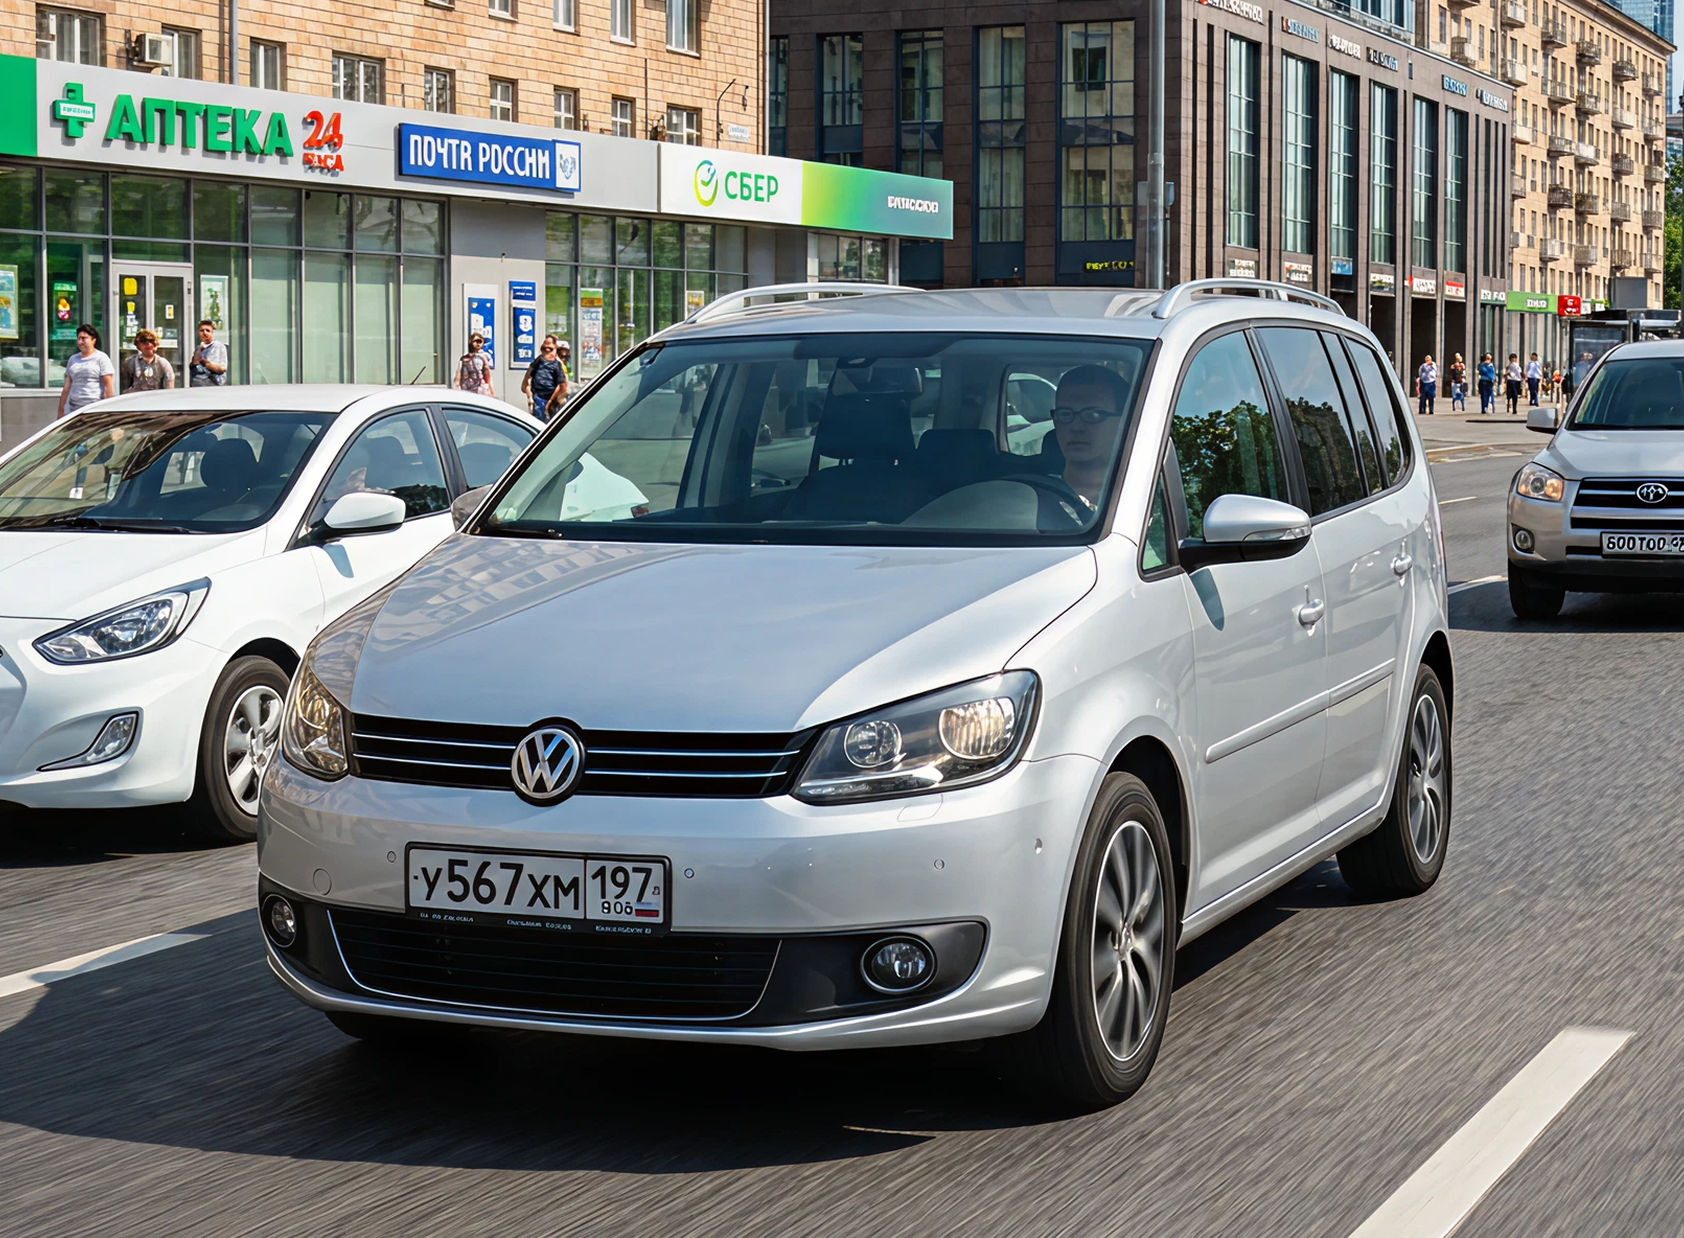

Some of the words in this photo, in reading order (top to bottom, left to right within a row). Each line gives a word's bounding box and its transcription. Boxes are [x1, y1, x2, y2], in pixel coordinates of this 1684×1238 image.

[105, 94, 294, 157] АПТЕКА
[303, 110, 344, 149] 24
[724, 171, 779, 203] СБЕР
[590, 865, 653, 903] 197
